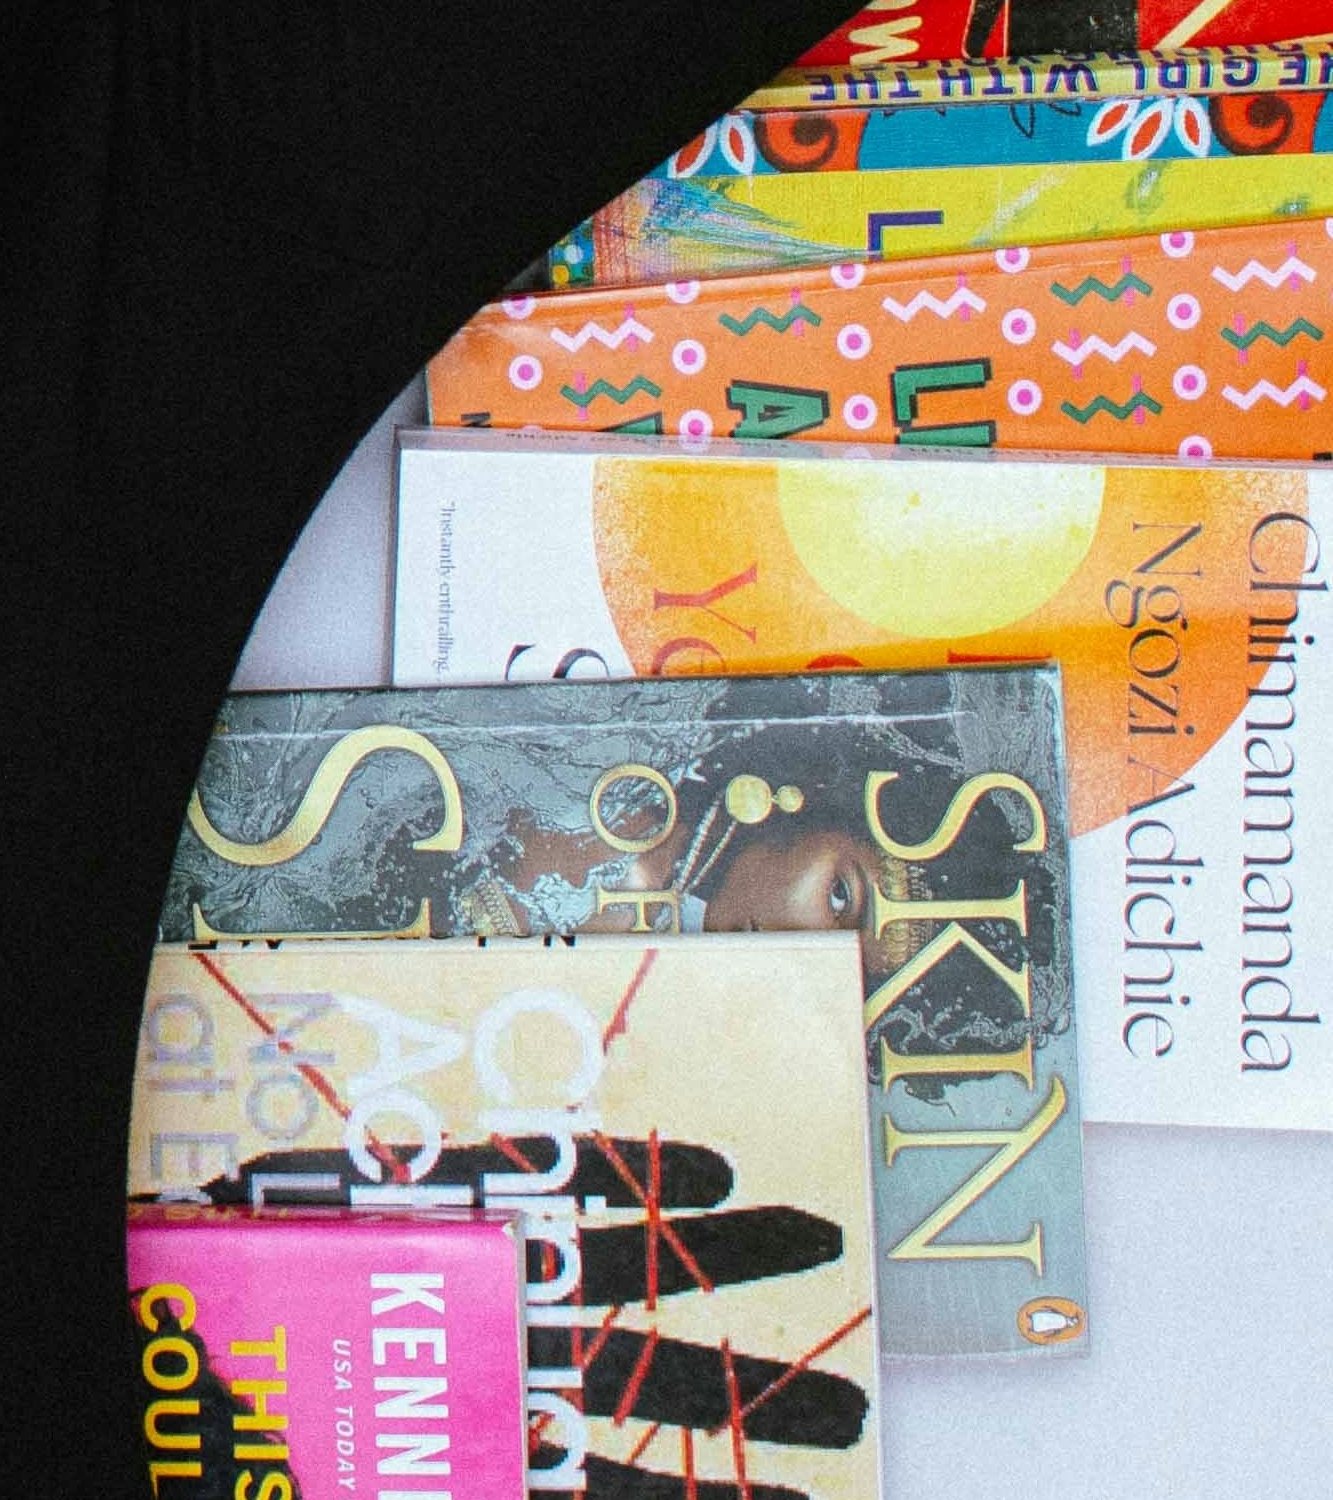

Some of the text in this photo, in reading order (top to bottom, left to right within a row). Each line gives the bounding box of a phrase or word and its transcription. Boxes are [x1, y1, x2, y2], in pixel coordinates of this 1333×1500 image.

[807, 70, 924, 104] THE
[934, 60, 1101, 100] WITH
[1134, 52, 1261, 92] GIRL
[1104, 520, 1207, 1060] Ngozi Adichie
[1239, 509, 1331, 1076] Chimamanda
[863, 768, 1070, 1279] SKIN
[332, 1337, 352, 1391] USA
[334, 1405, 357, 1492] TODAY
